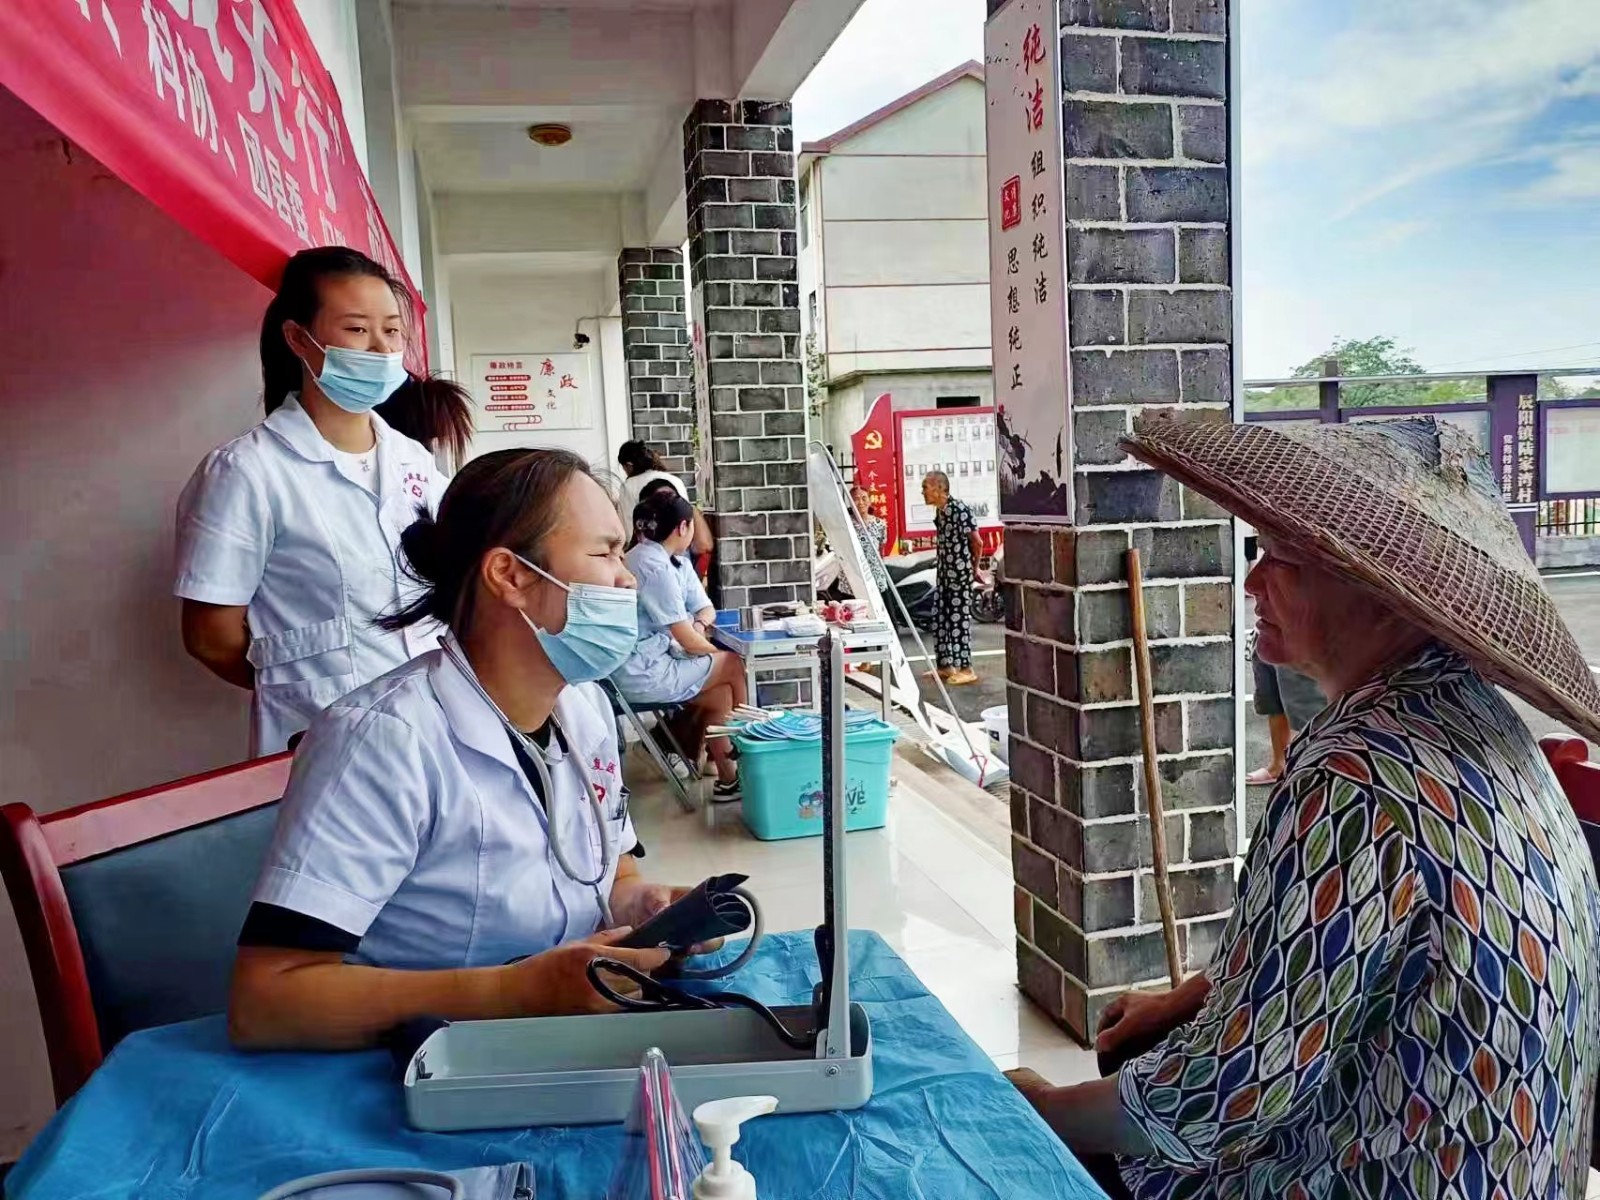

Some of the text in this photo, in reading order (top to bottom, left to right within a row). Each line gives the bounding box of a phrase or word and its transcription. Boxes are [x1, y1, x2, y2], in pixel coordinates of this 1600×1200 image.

[1022, 23, 1046, 135] 纯洁
[1031, 149, 1048, 304] 组织纯洁
[1007, 246, 1023, 391] 思想纯正
